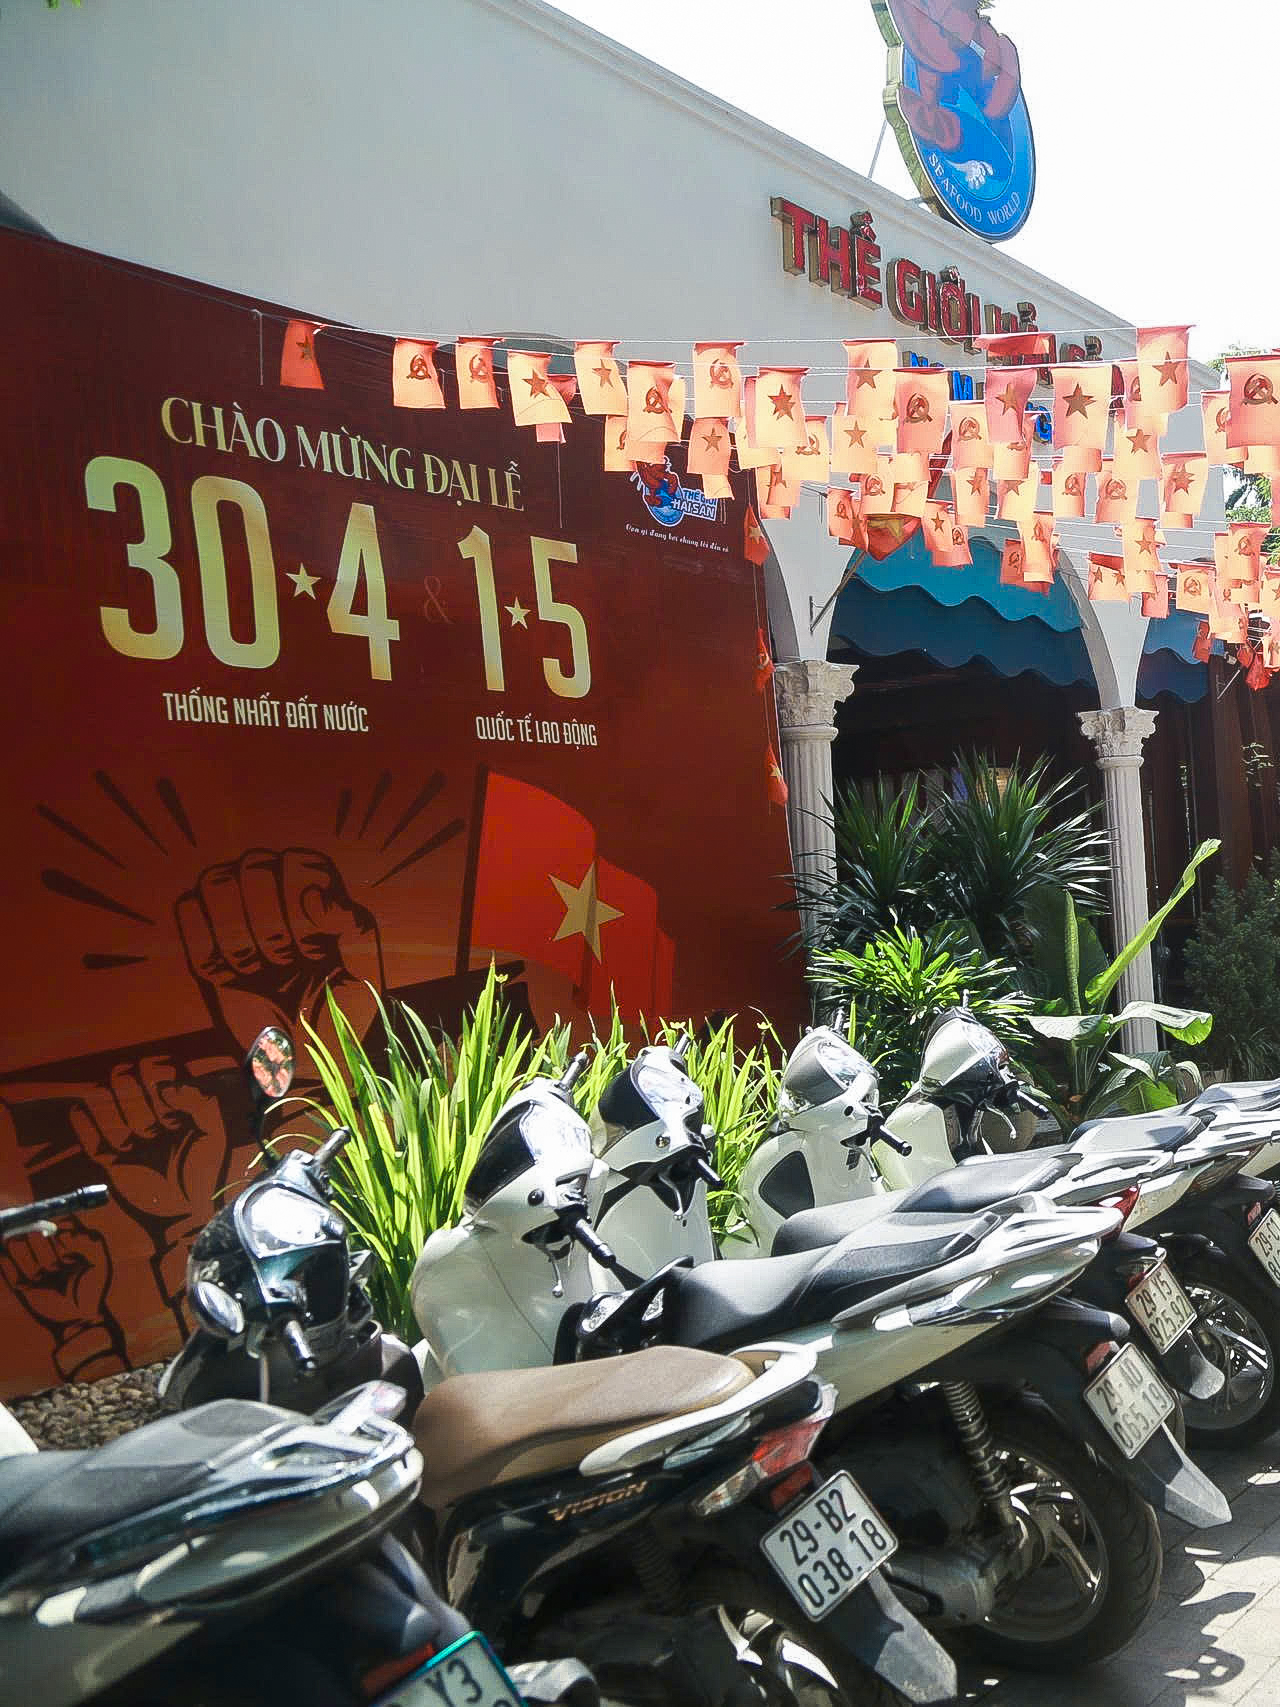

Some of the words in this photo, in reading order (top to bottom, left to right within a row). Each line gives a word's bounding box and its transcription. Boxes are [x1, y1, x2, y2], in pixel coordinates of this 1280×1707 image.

[929, 152, 982, 222] SEAFOOD
[987, 192, 1021, 224] WORLD
[770, 196, 883, 310] THẾ
[161, 397, 287, 463] CHÀO
[295, 425, 416, 489] MỪNG
[422, 453, 481, 507] ĐẠI
[487, 460, 525, 511] LỄ
[162, 686, 230, 724] THỐNG
[233, 692, 281, 727] NHẤT
[285, 695, 319, 729] ĐẤT
[323, 700, 369, 732] NƯỚC
[475, 711, 515, 741] QUỐC
[516, 713, 534, 742] TẾ
[535, 720, 561, 744] LAO
[562, 718, 598, 750] ĐỘNG
[1113, 1382, 1168, 1449] 065.19
[547, 1480, 648, 1521] VISION
[779, 1488, 857, 1567] 29-B2
[798, 1518, 888, 1608] 038.18
